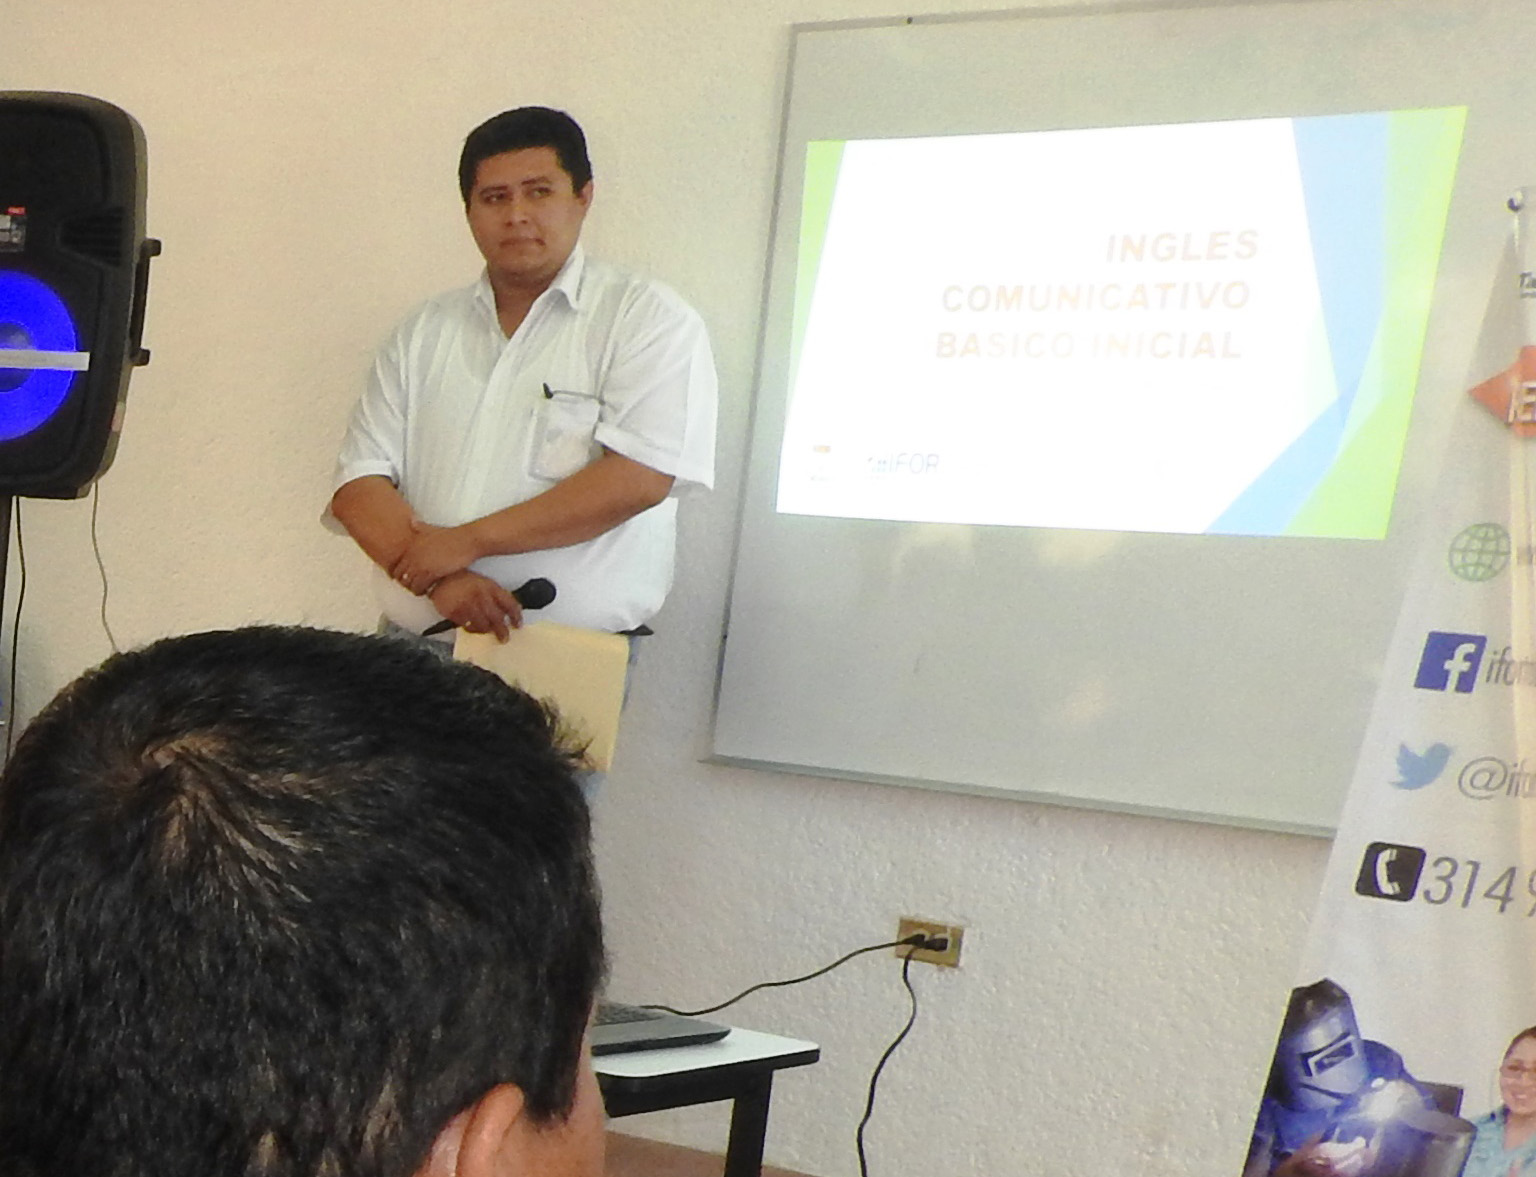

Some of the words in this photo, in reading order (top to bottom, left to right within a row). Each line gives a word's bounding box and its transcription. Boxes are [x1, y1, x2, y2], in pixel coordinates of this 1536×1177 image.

[1105, 228, 1260, 264] INGLES
[941, 280, 1252, 313] COMUNICATIVO
[935, 331, 1076, 360] BASICO
[1091, 330, 1243, 360] INICIAL
